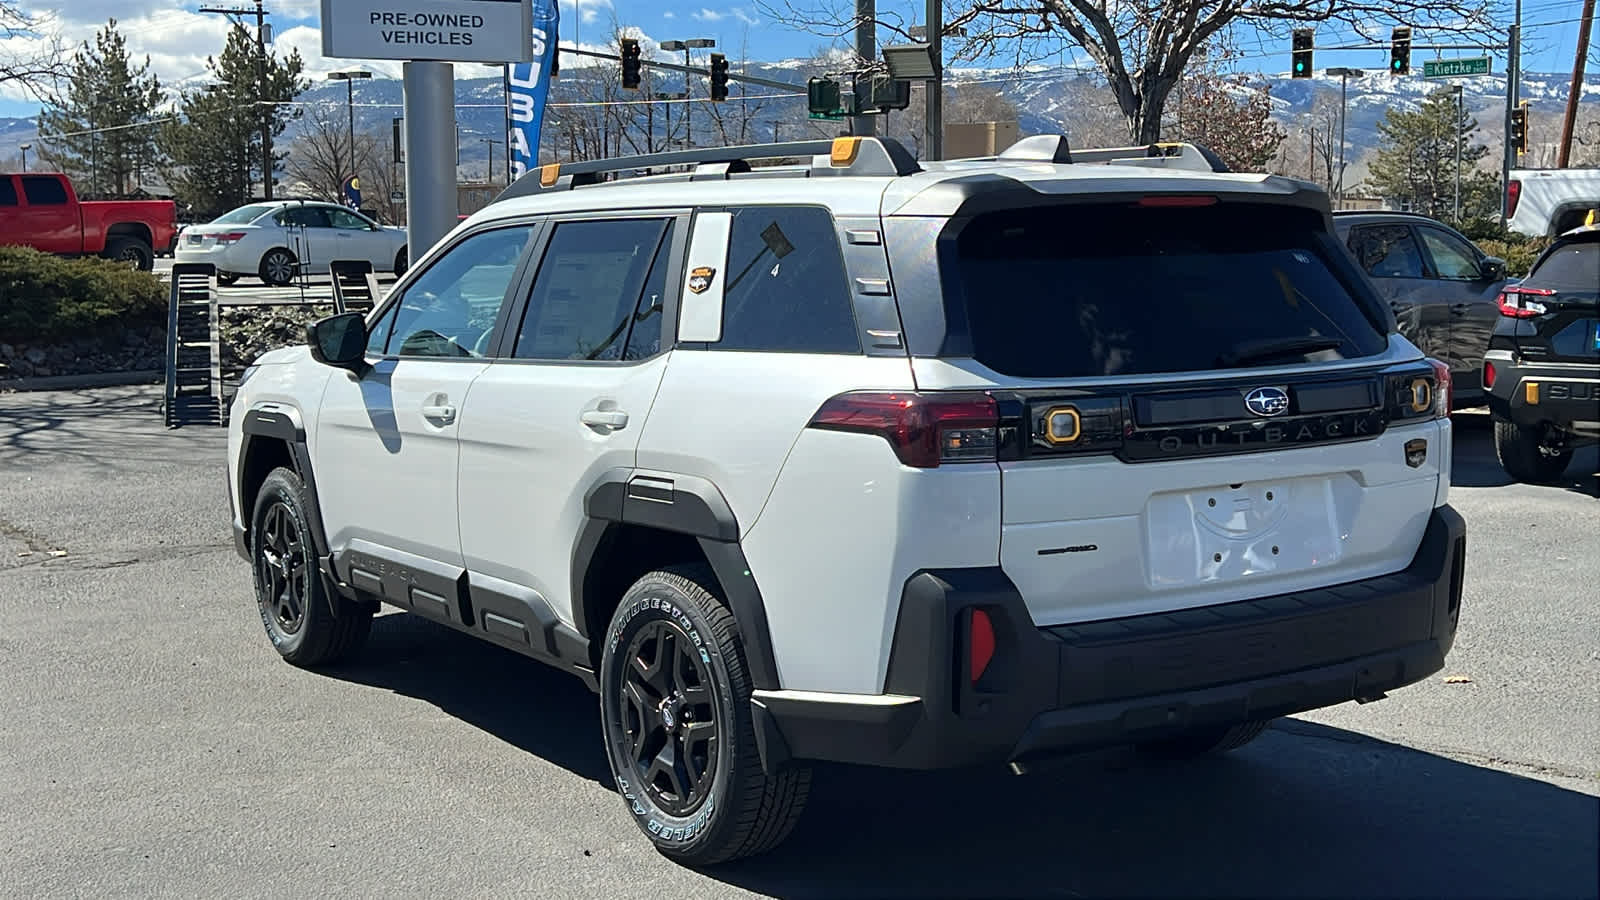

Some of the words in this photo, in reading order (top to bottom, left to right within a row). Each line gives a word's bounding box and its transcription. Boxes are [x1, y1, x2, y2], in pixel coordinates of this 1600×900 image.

[370, 12, 484, 28] PRE-OWNED
[381, 30, 473, 46] VEHICLES
[1434, 62, 1472, 75] Kietzke
[1160, 418, 1368, 452] OUTBACK
